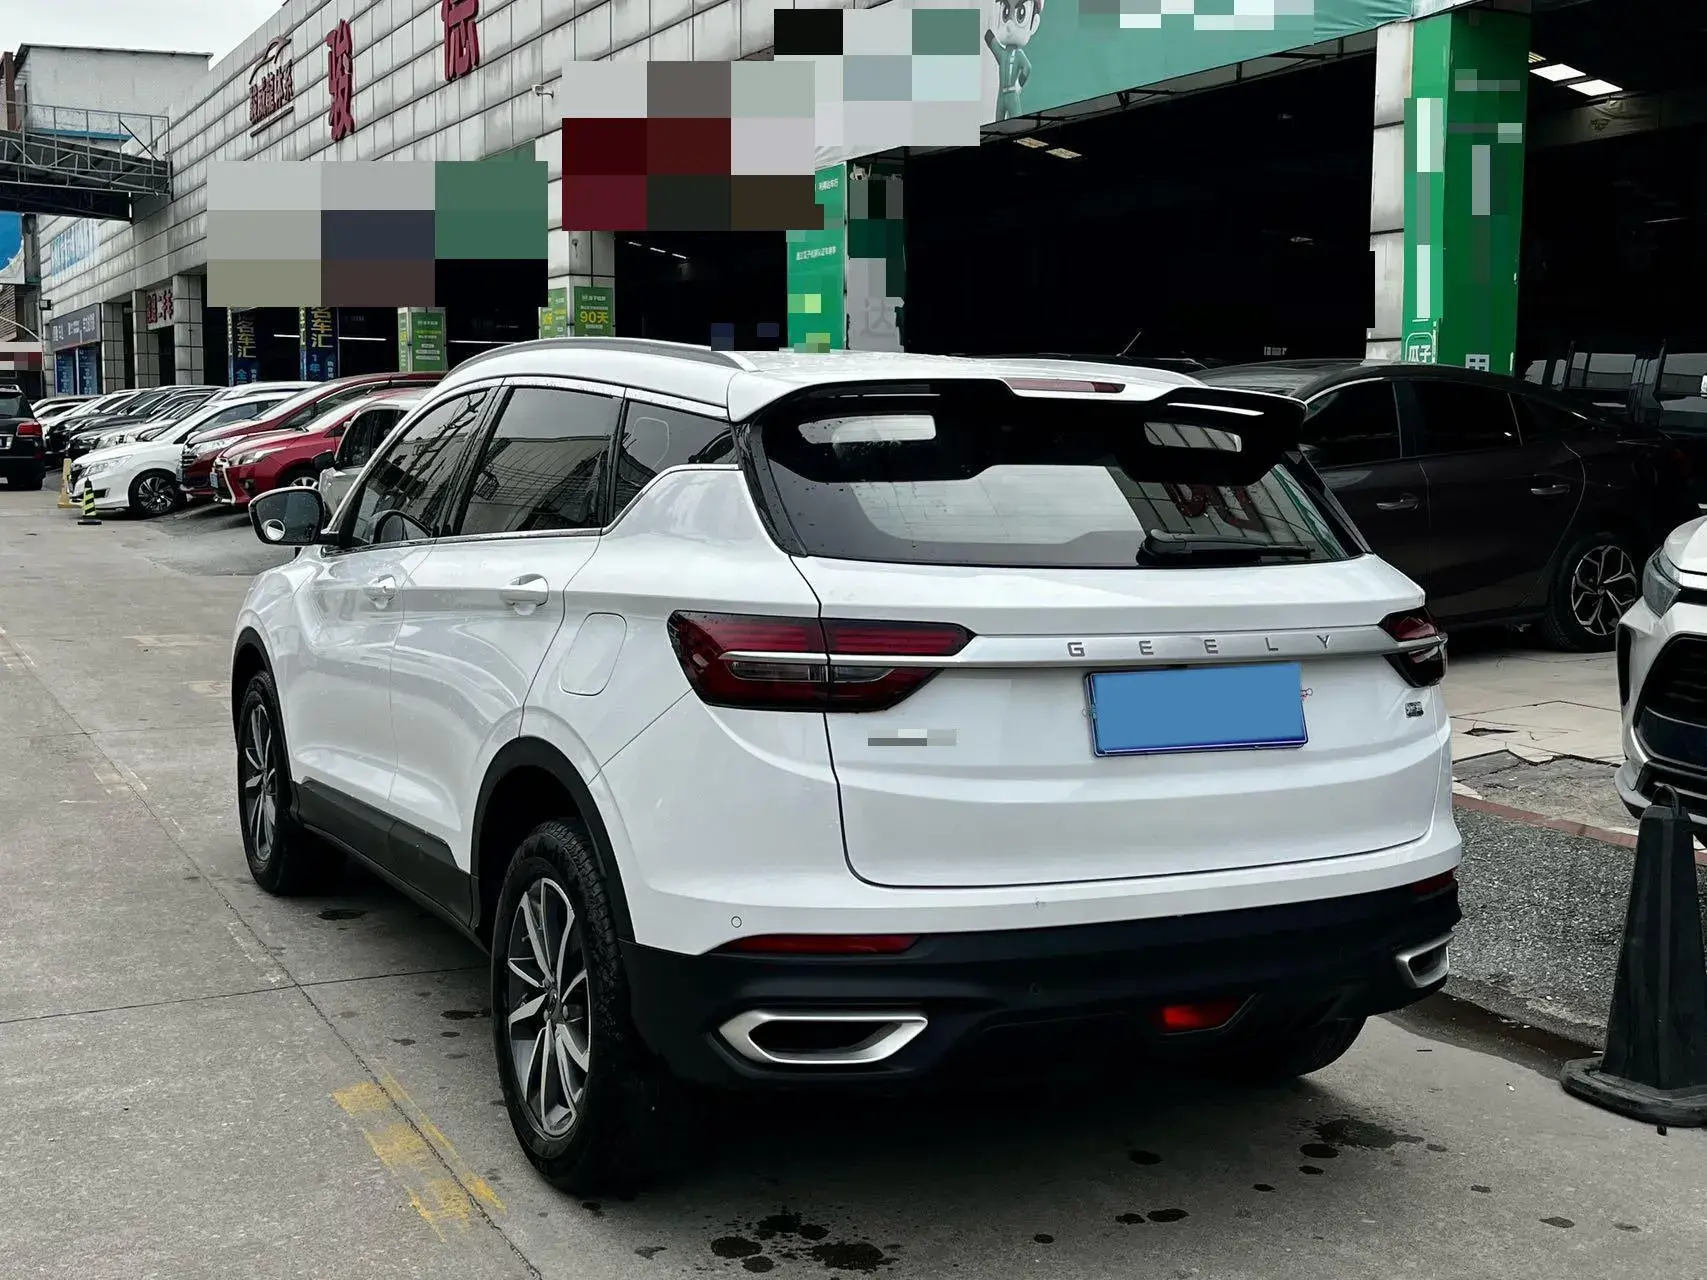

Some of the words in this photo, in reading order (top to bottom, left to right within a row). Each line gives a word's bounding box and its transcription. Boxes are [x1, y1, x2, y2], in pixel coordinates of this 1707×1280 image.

[580, 311, 609, 324] 90天
[1409, 344, 1432, 363] 瓜子
[1067, 635, 1330, 657] GEELY
